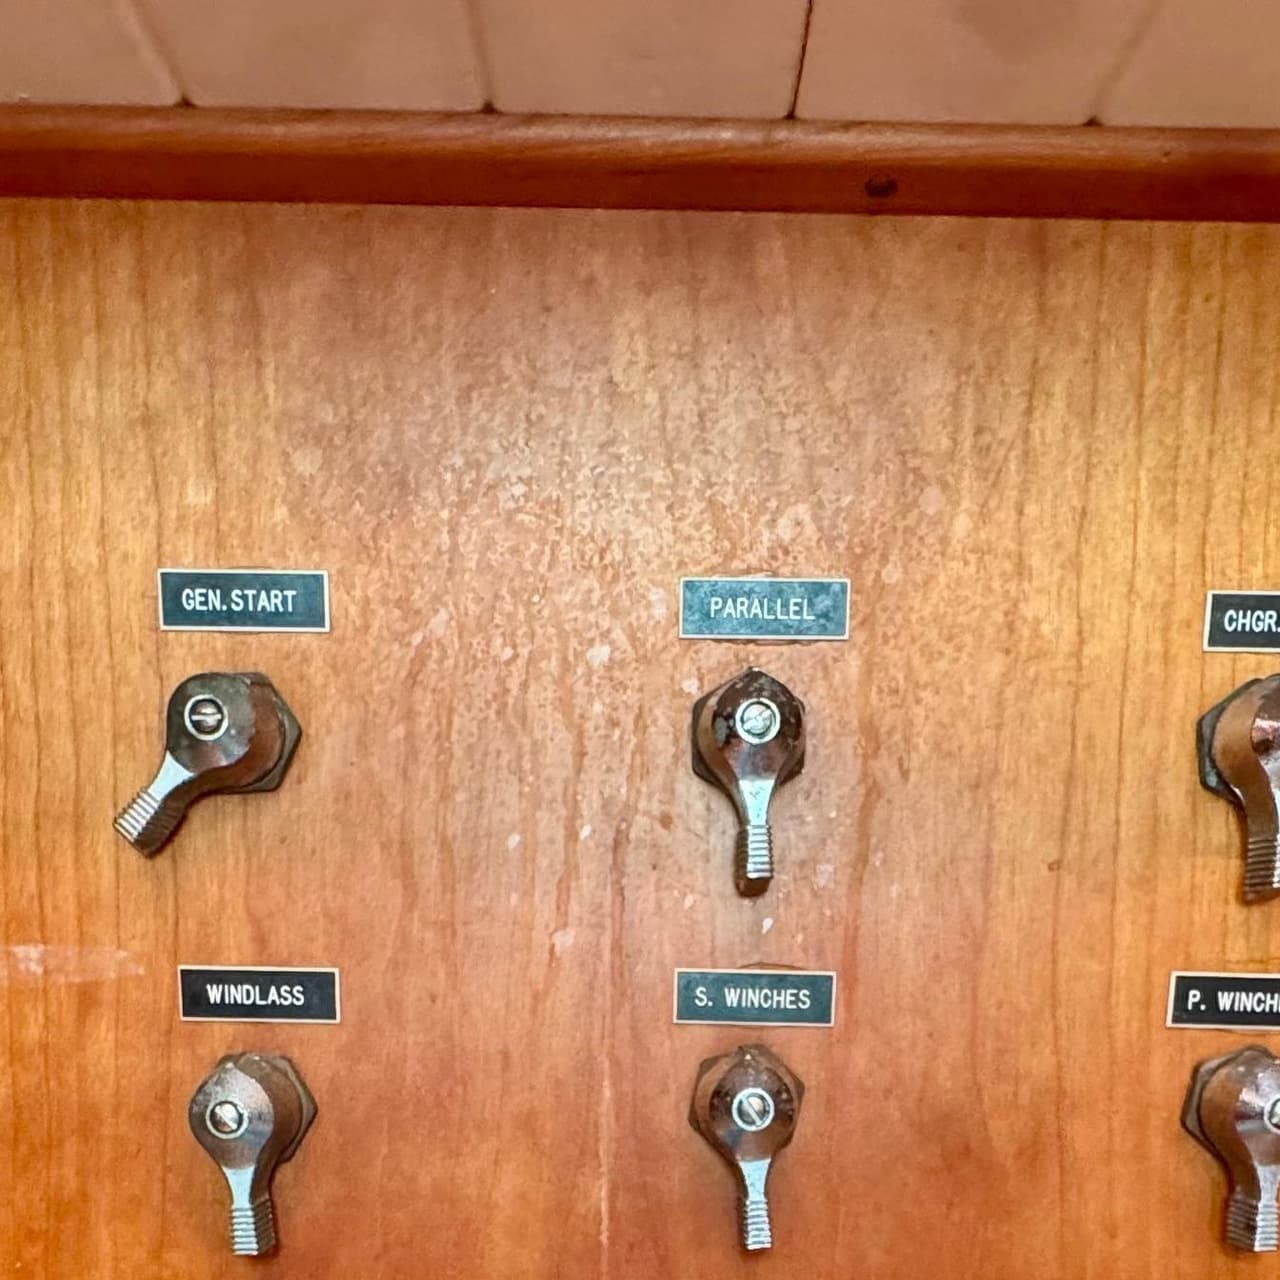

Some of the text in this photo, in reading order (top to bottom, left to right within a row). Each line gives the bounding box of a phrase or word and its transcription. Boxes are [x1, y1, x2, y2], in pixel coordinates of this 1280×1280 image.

[181, 588, 297, 613] GEN.START
[710, 598, 816, 621] PARALLEL
[206, 983, 306, 1007] WINDLASS
[694, 986, 811, 1010] S. WINCHES
[1187, 989, 1206, 1011] P.
